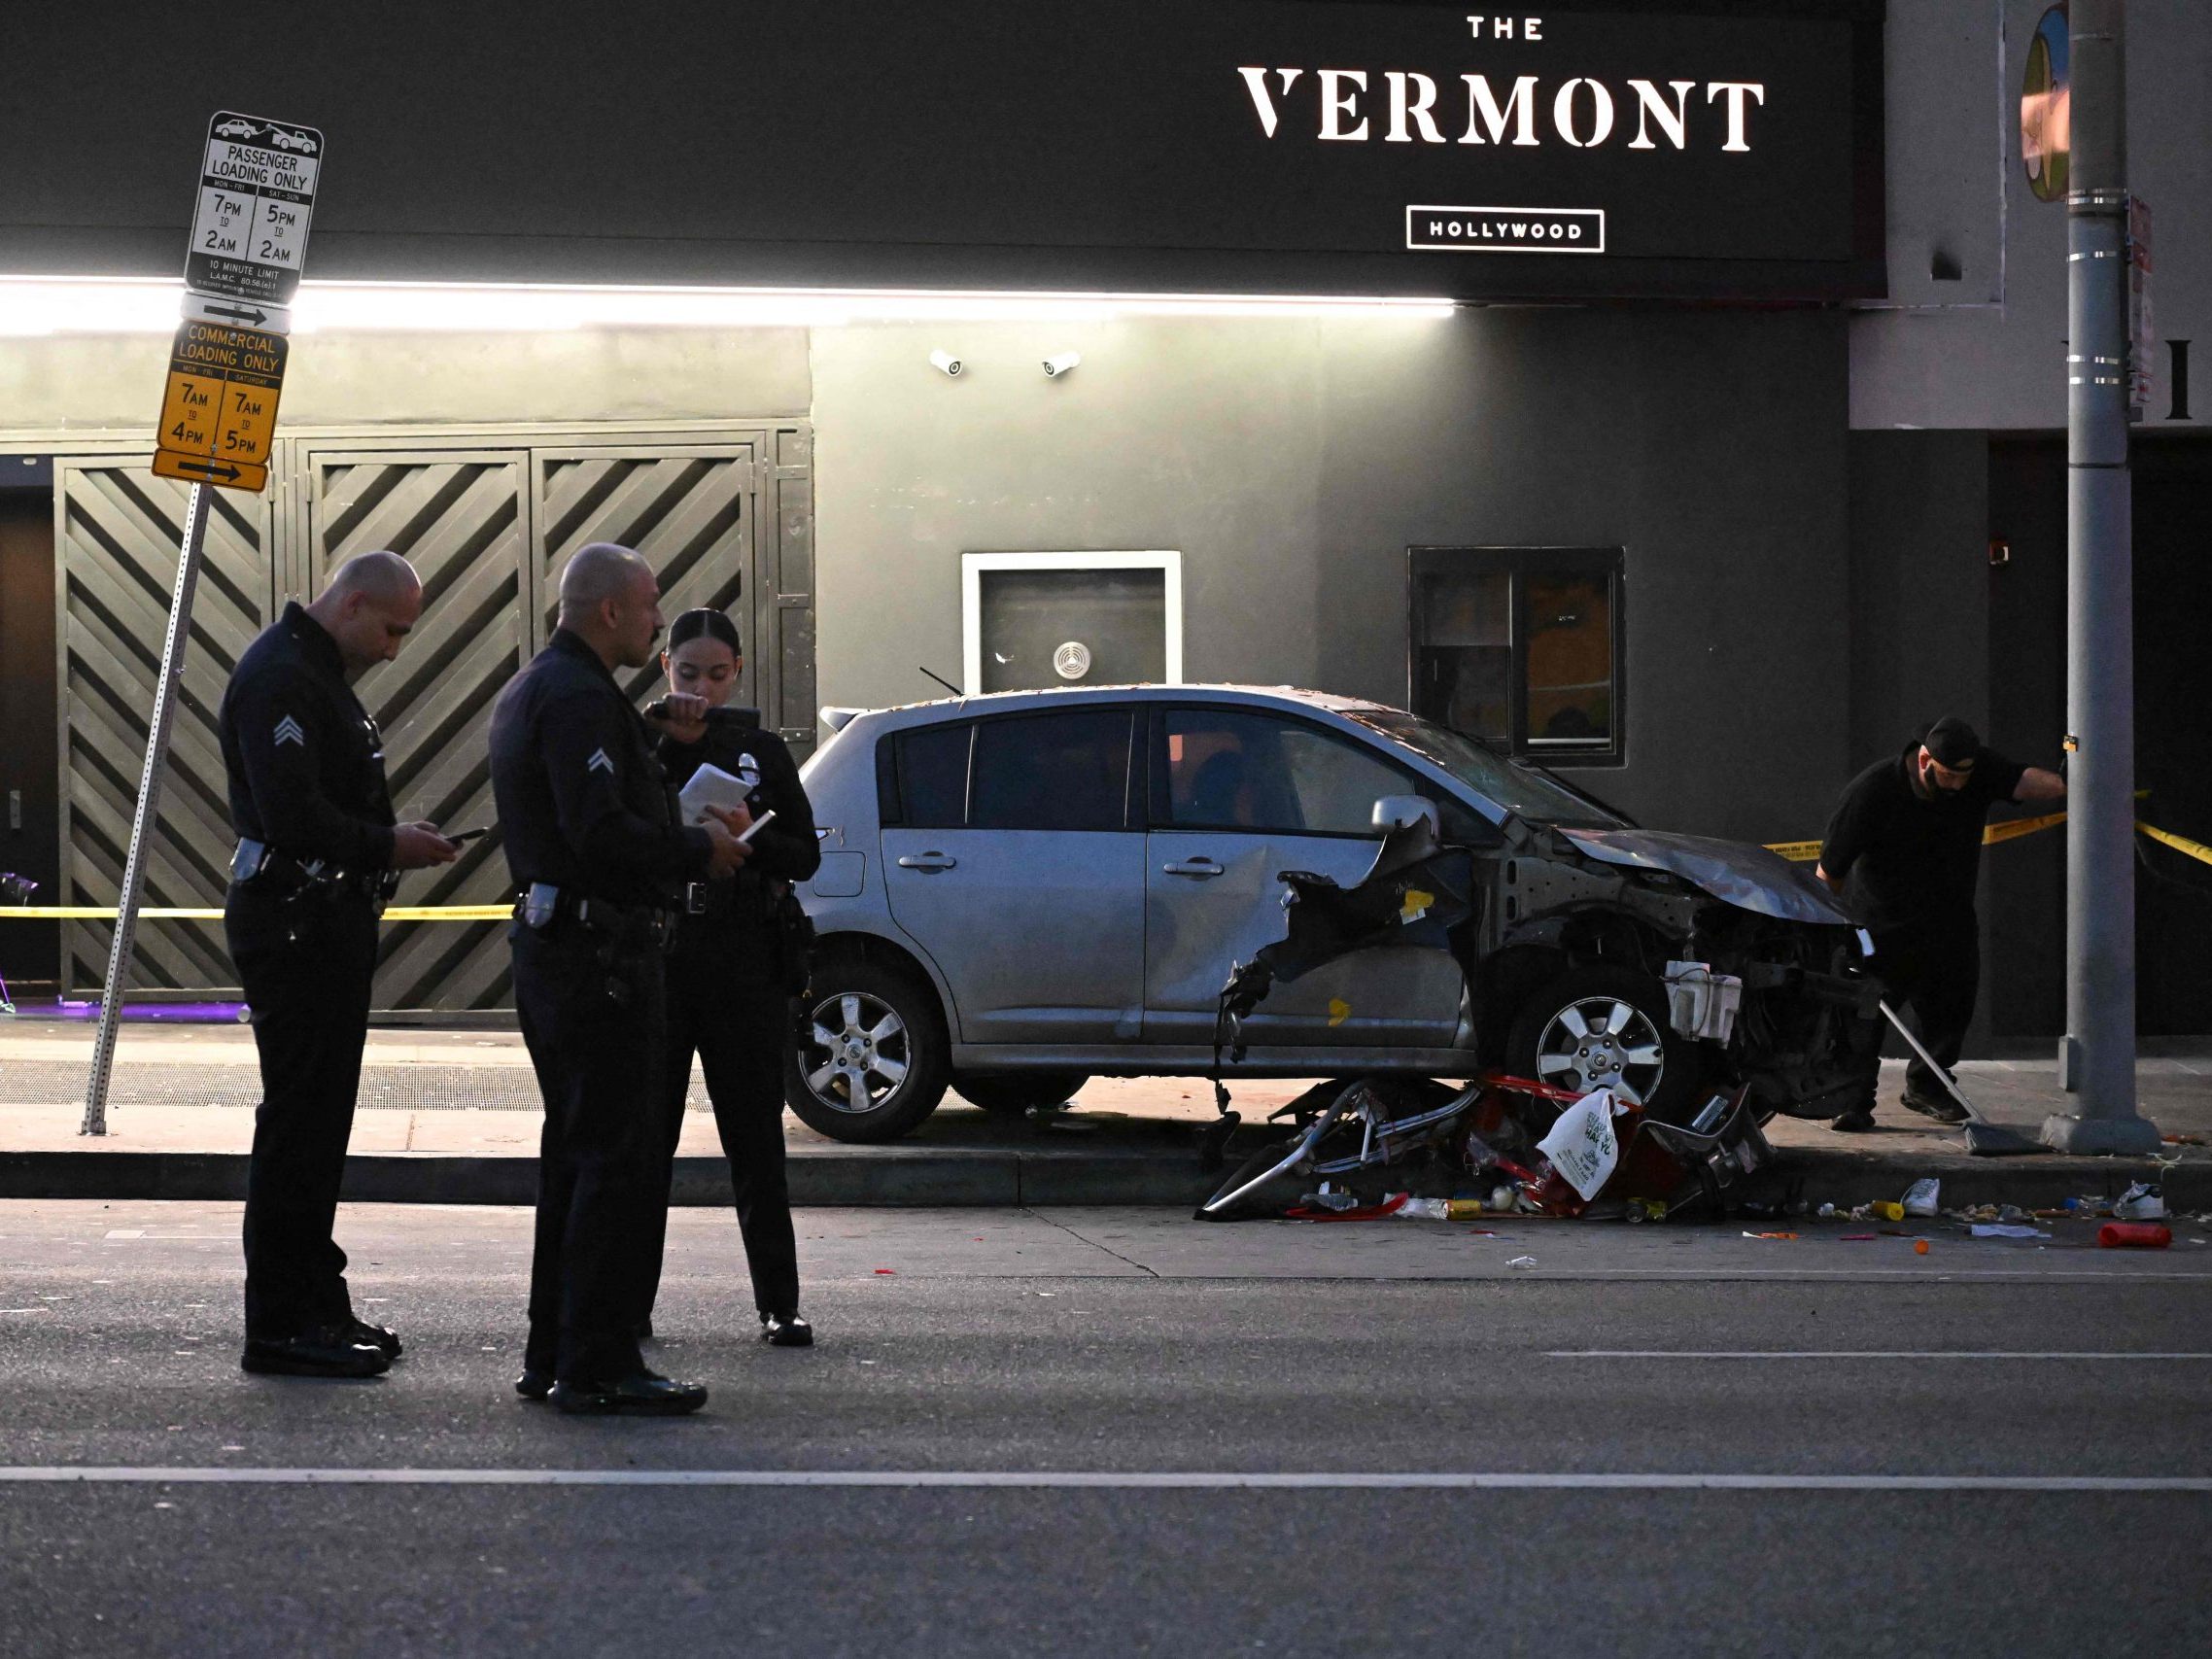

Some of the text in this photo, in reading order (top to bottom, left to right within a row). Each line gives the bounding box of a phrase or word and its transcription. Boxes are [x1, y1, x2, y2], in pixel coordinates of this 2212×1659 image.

[1467, 16, 1543, 41] THE
[1237, 66, 1764, 153] VERMONT
[227, 146, 298, 172] PASSENGER
[212, 159, 308, 190] LOADING ONLY
[214, 194, 242, 217] 7PM
[266, 204, 295, 226] 5PM
[221, 217, 229, 225] TO
[275, 226, 284, 235] TO
[1430, 221, 1582, 240] HOLLYWOOD
[205, 229, 236, 252] 2AM
[259, 240, 291, 262] 2AM
[210, 259, 280, 280] 10 MINUTE LIMIT
[189, 326, 276, 353] COMMERCIAL
[179, 342, 280, 372] LOADING ONLY
[234, 373, 269, 385] SATURDAY
[182, 383, 208, 406] 7AM
[235, 393, 261, 416] 7AM
[189, 409, 197, 419] TO
[242, 419, 251, 428] TO
[171, 422, 203, 444] 4PM
[225, 431, 257, 454] 5PM
